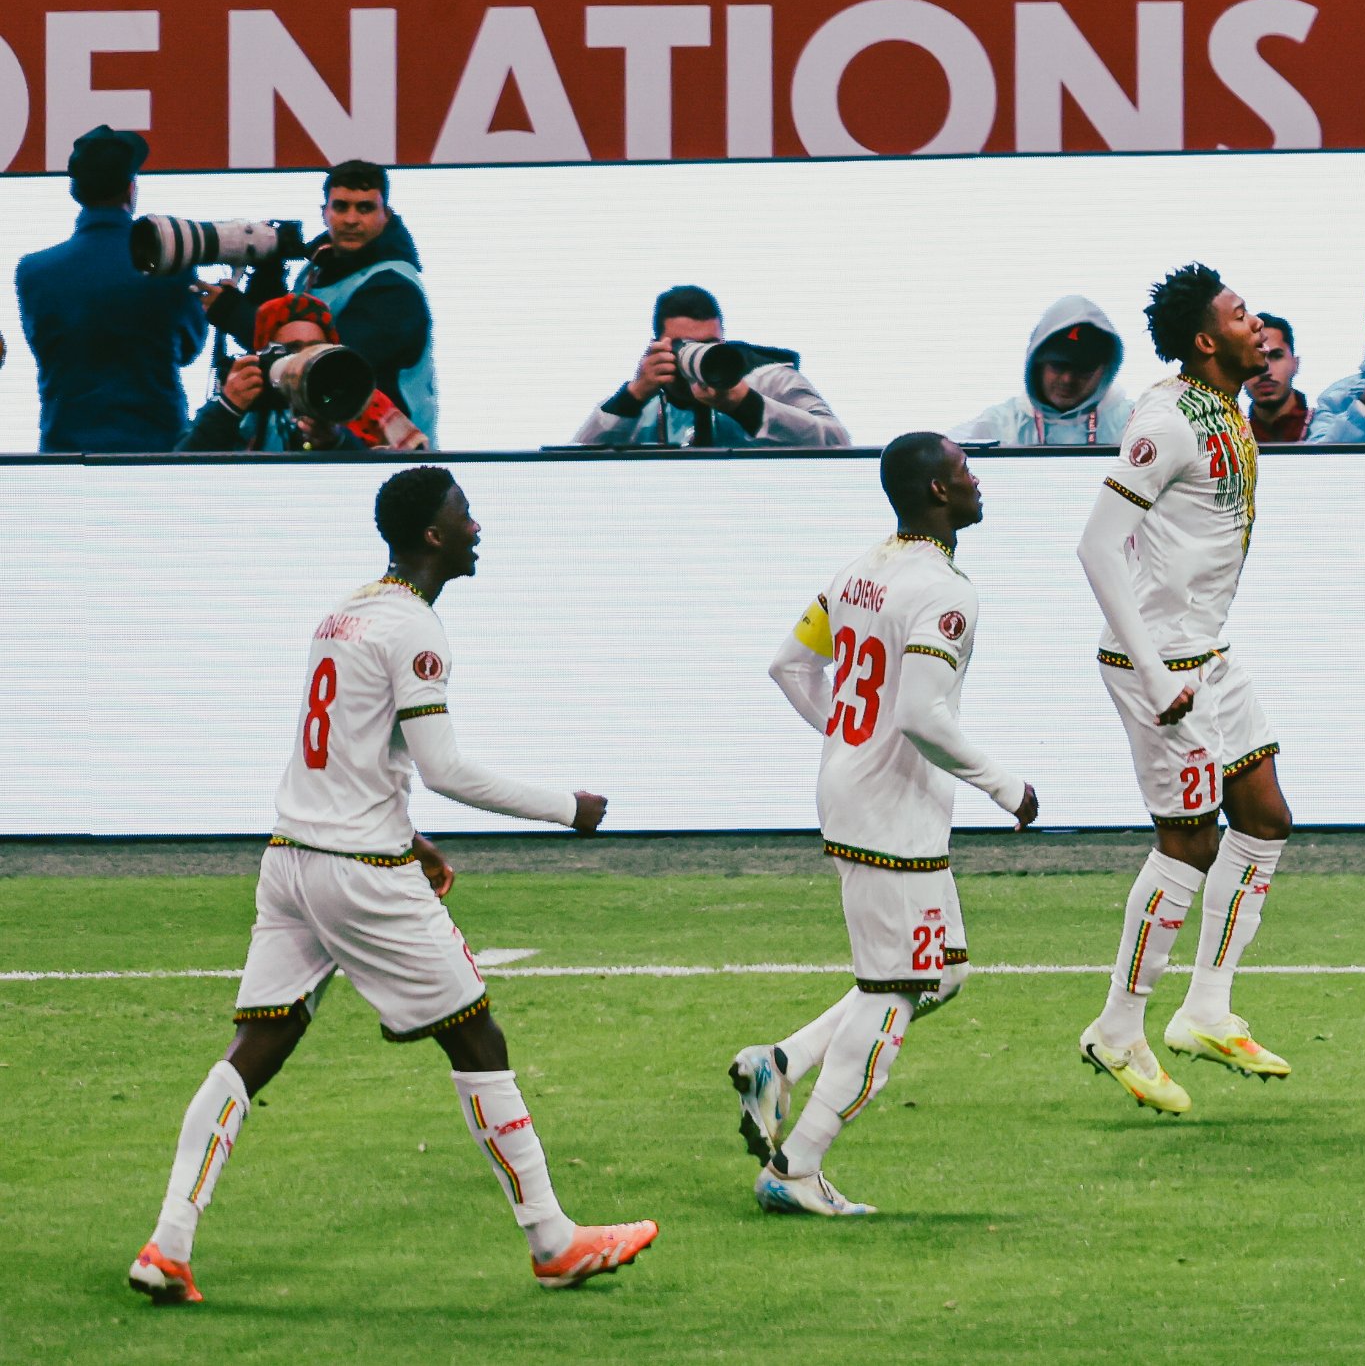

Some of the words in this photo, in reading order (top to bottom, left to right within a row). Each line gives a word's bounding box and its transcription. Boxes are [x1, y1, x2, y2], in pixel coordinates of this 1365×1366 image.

[0, 10, 160, 174] F
[1206, 431, 1239, 479] 21
[840, 578, 888, 613] A.DIENG
[303, 657, 337, 770] 8
[825, 625, 886, 747] 23
[1180, 762, 1216, 810] 21
